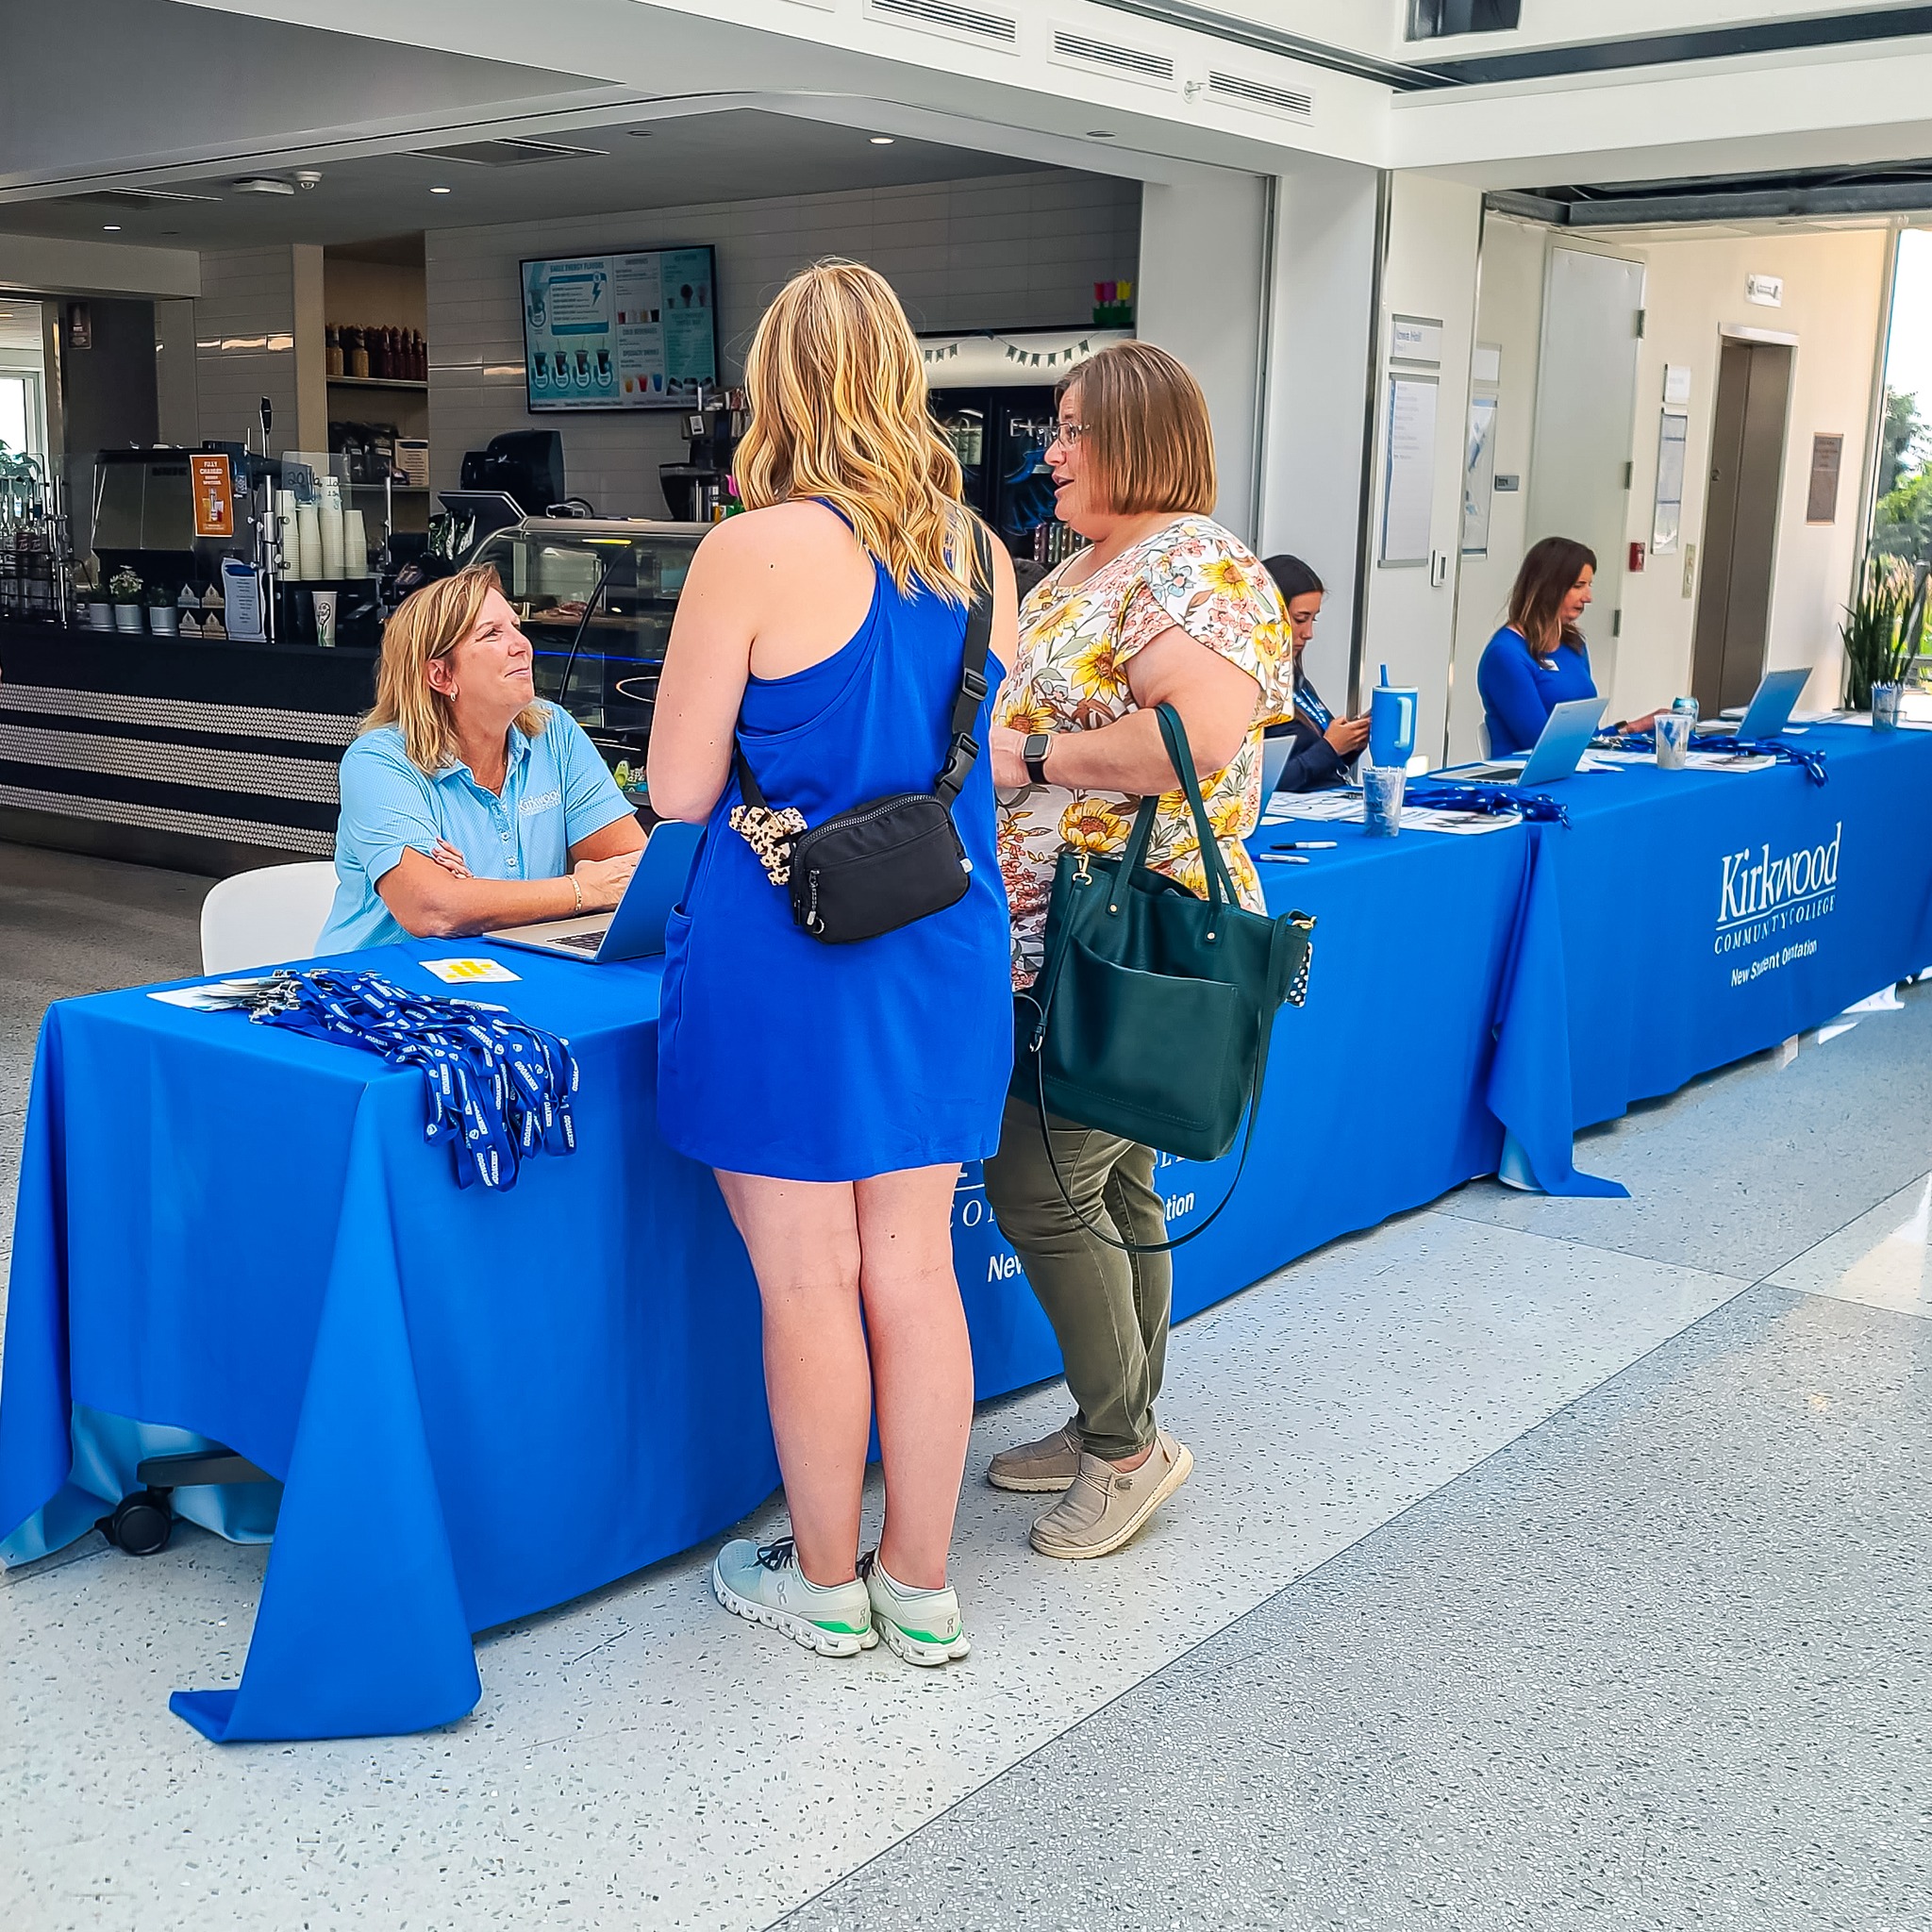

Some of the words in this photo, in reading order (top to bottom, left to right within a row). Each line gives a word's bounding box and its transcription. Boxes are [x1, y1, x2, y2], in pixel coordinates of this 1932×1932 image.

[1717, 820, 1841, 923] Kirkwood
[1714, 910, 1789, 955] COMMUNTY
[1730, 968, 1750, 988] New
